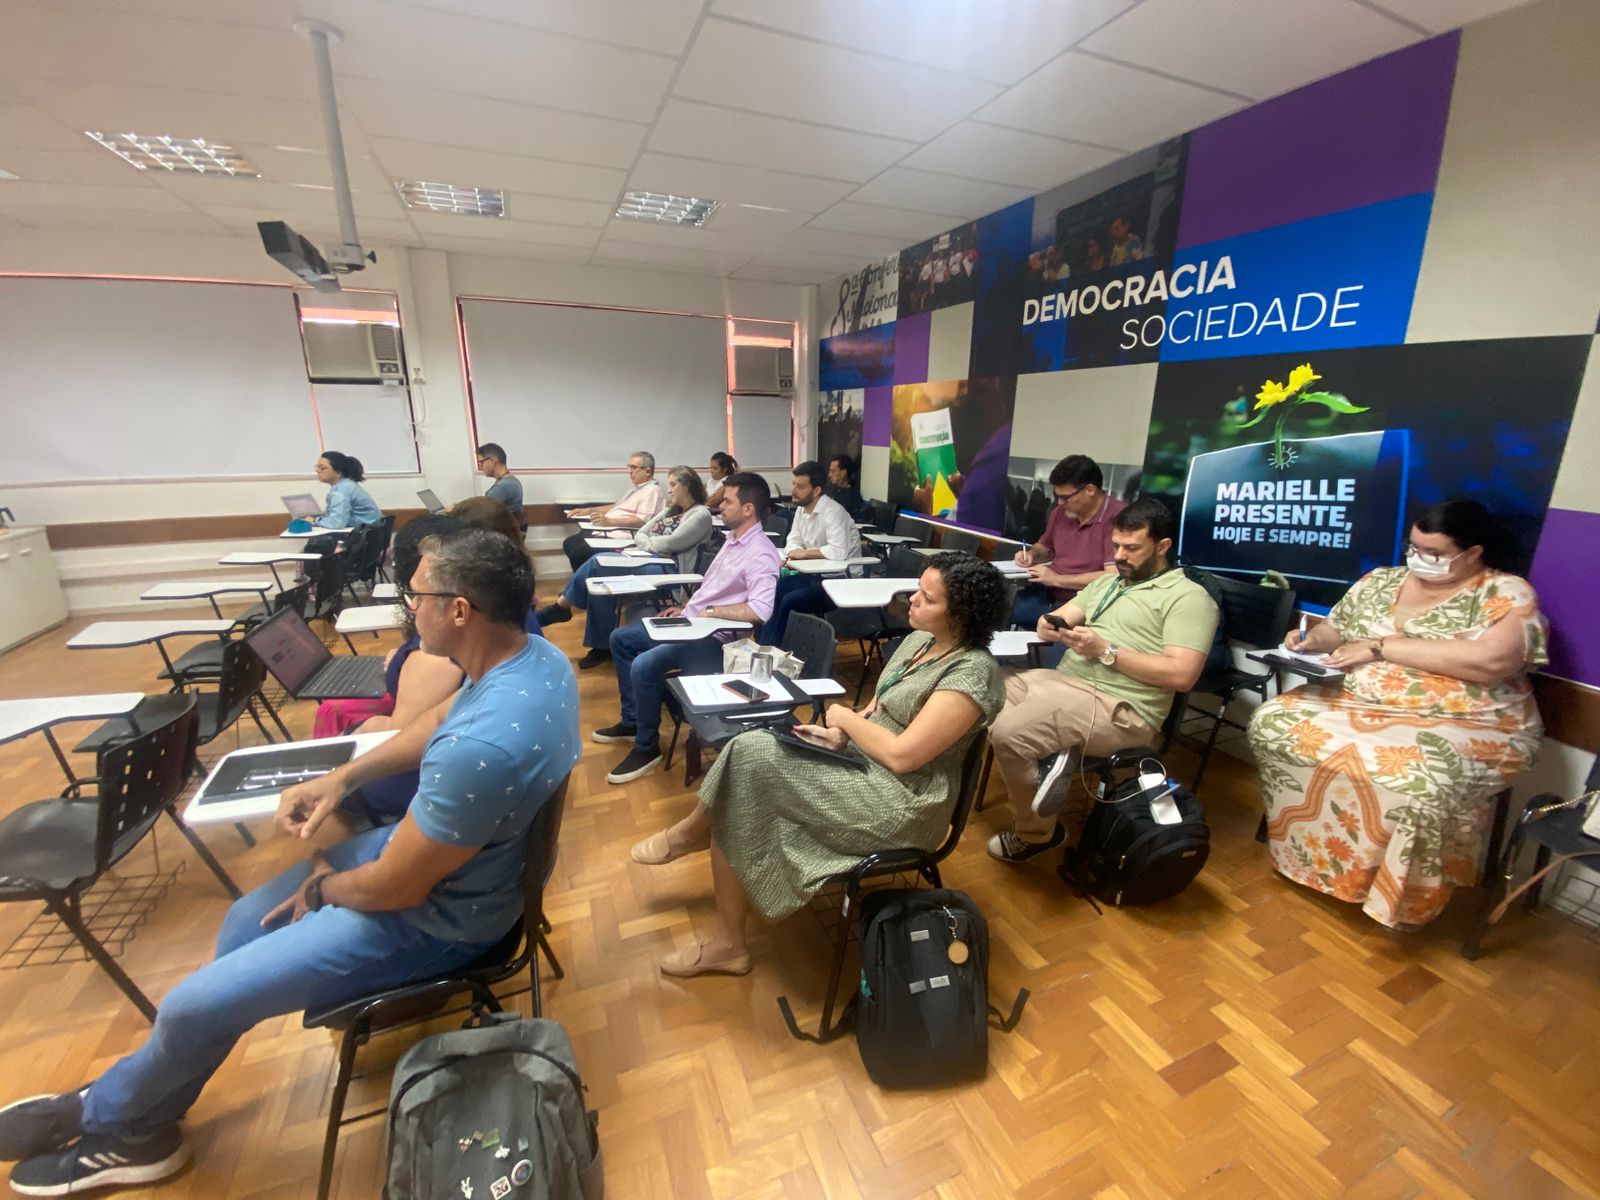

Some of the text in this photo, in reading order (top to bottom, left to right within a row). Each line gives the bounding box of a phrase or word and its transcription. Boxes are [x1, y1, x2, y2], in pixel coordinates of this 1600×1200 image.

[1022, 255, 1236, 326] DEMOCRACIA
[1120, 285, 1365, 350] SOCIEDADE
[1216, 478, 1356, 502] MARIELLE
[1214, 504, 1353, 531] PRESENTE,
[1212, 526, 1352, 549] HOJE E SEMPRE!
